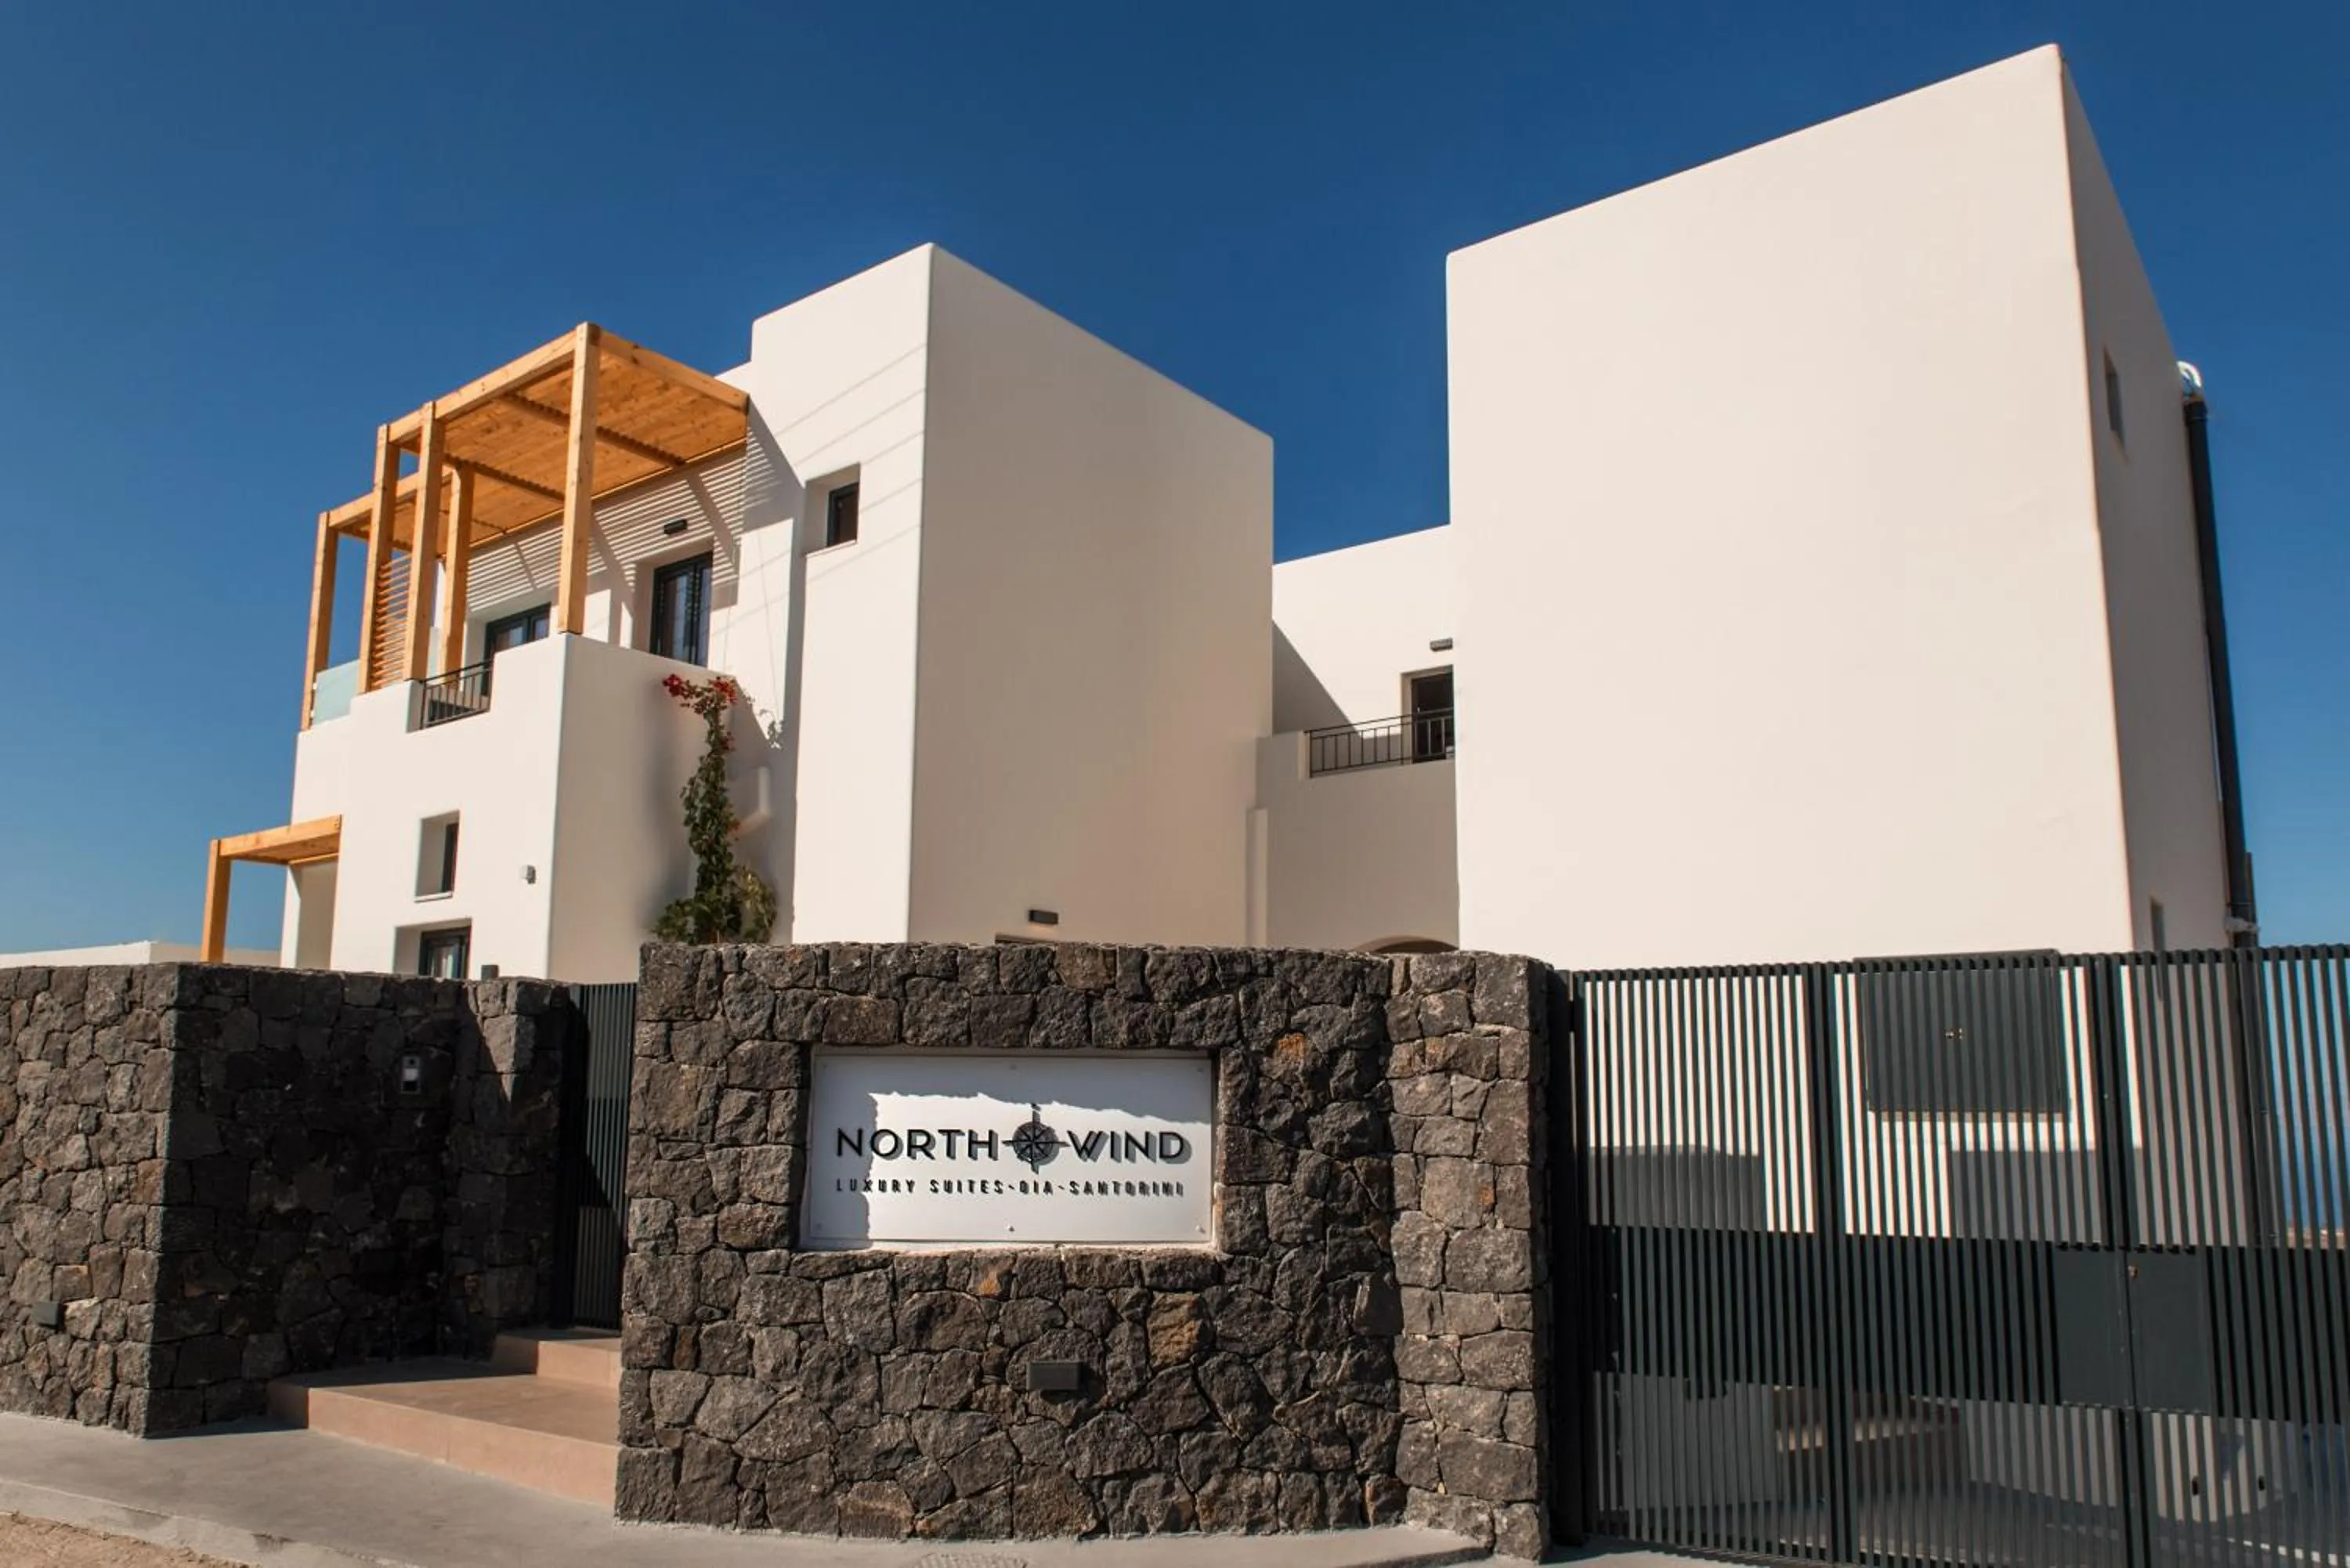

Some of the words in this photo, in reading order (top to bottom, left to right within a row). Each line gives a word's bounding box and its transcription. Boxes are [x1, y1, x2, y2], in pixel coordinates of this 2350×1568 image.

[837, 1127, 995, 1158] NORTH
[1068, 1130, 1186, 1159] WIND
[836, 1179, 914, 1193] LUXURY
